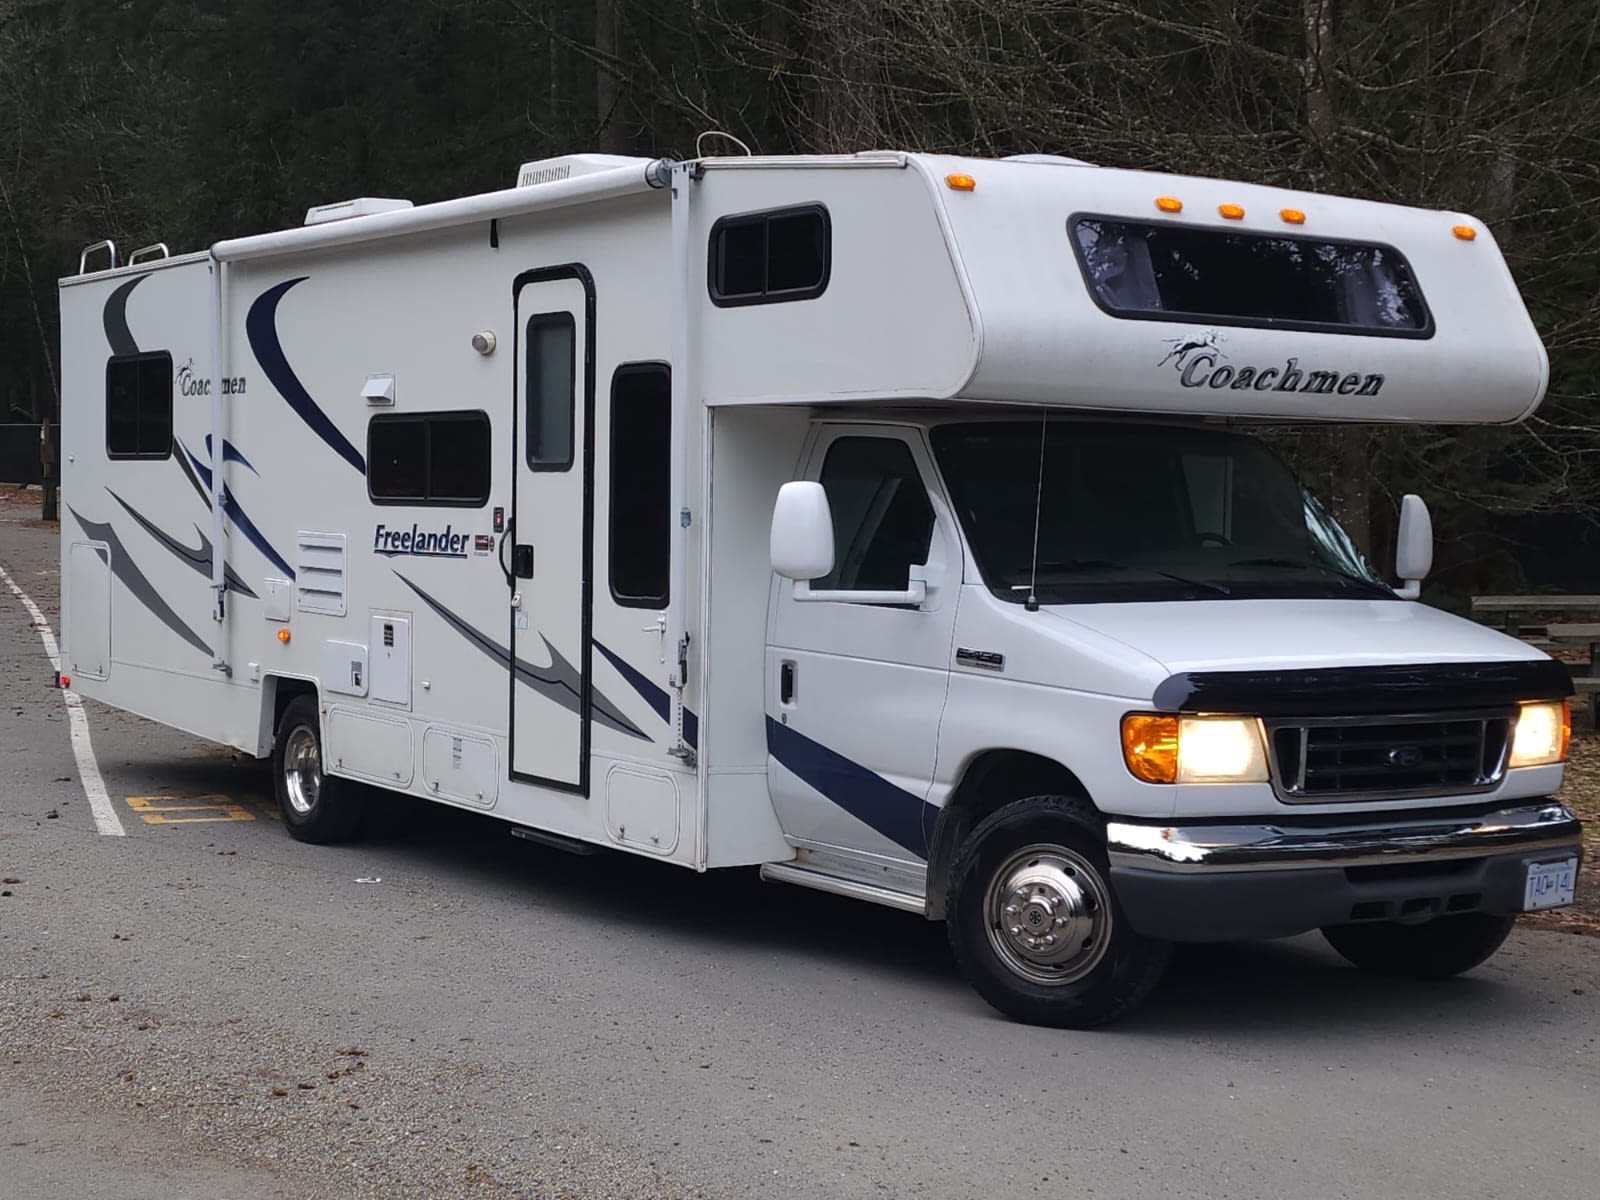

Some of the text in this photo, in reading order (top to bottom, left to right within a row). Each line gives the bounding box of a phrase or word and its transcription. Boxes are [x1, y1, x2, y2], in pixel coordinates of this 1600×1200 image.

[181, 373, 246, 397] Coacmen
[1180, 352, 1385, 396] Coachmen
[374, 523, 470, 553] Freelander
